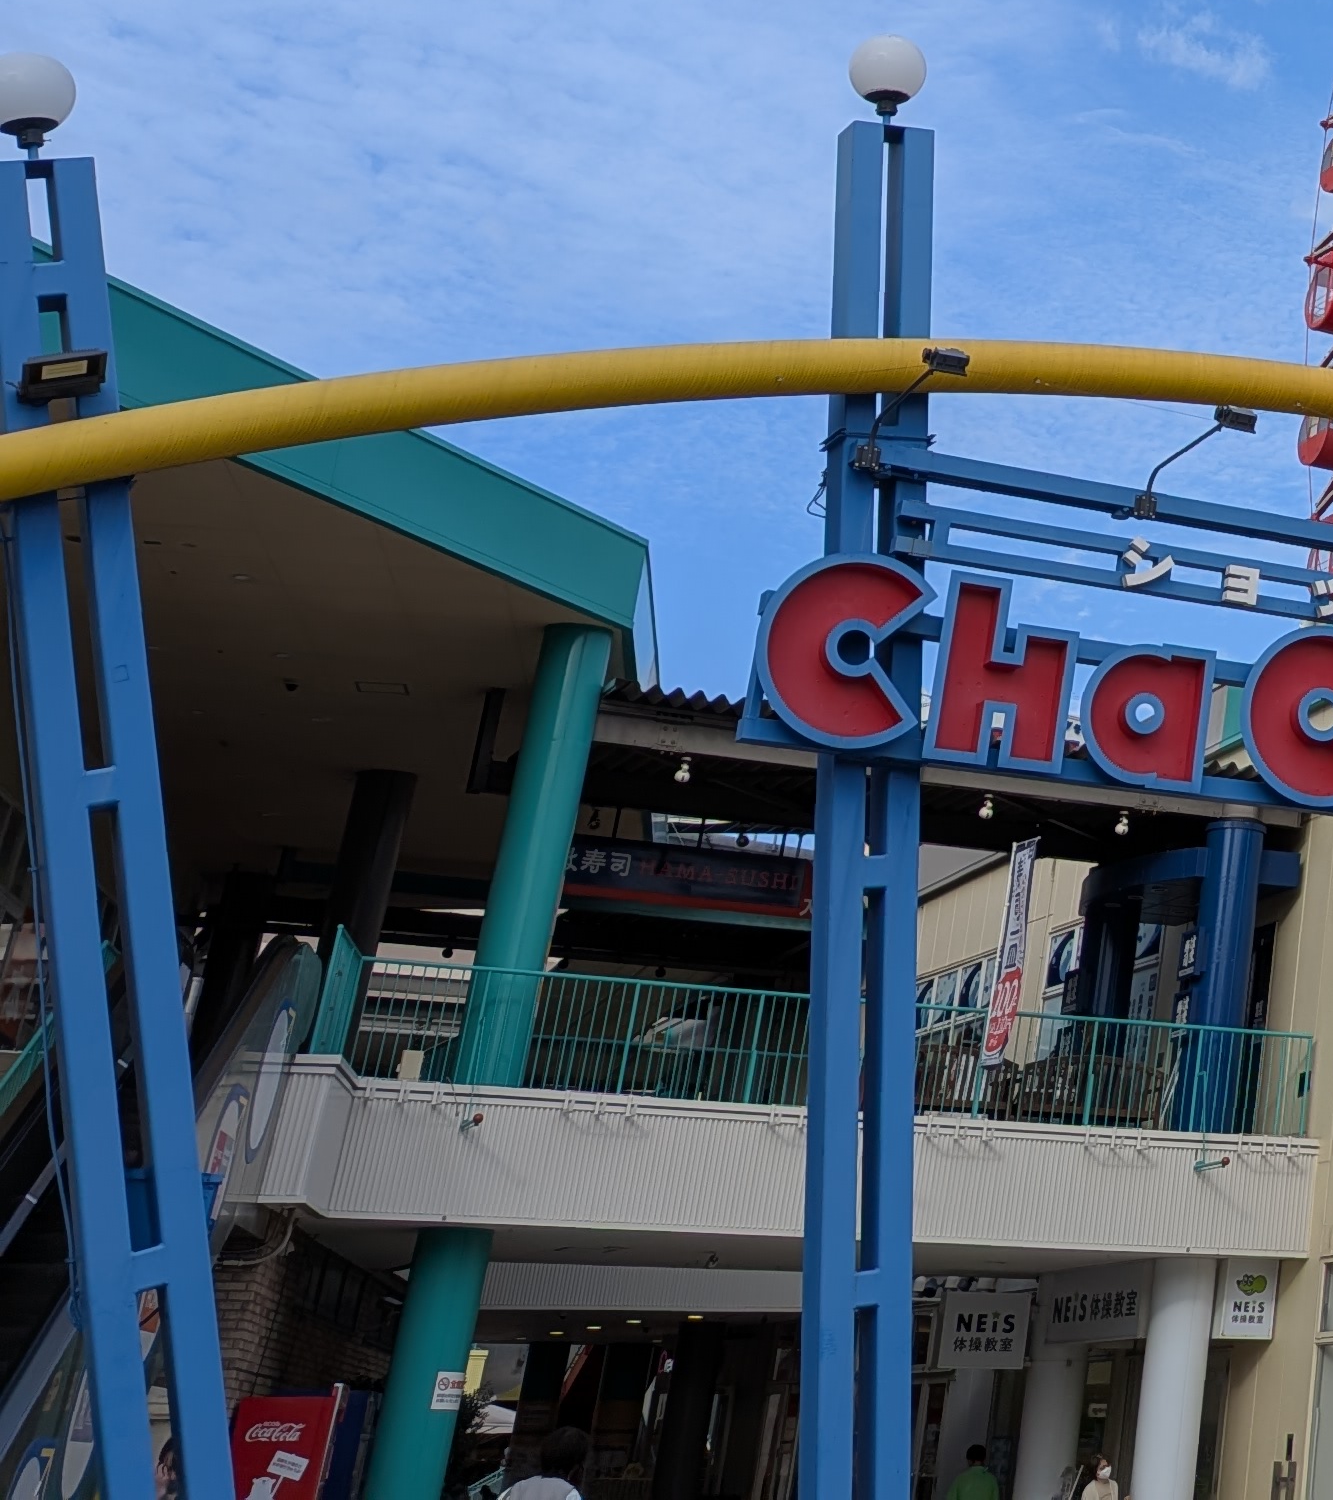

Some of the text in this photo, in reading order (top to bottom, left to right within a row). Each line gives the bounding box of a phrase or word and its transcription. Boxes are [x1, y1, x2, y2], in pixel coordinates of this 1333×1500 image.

[1089, 1290, 1138, 1321] 体操教室
[1231, 1314, 1264, 1324] 体操教室
[953, 1337, 1013, 1353] 体操教室
